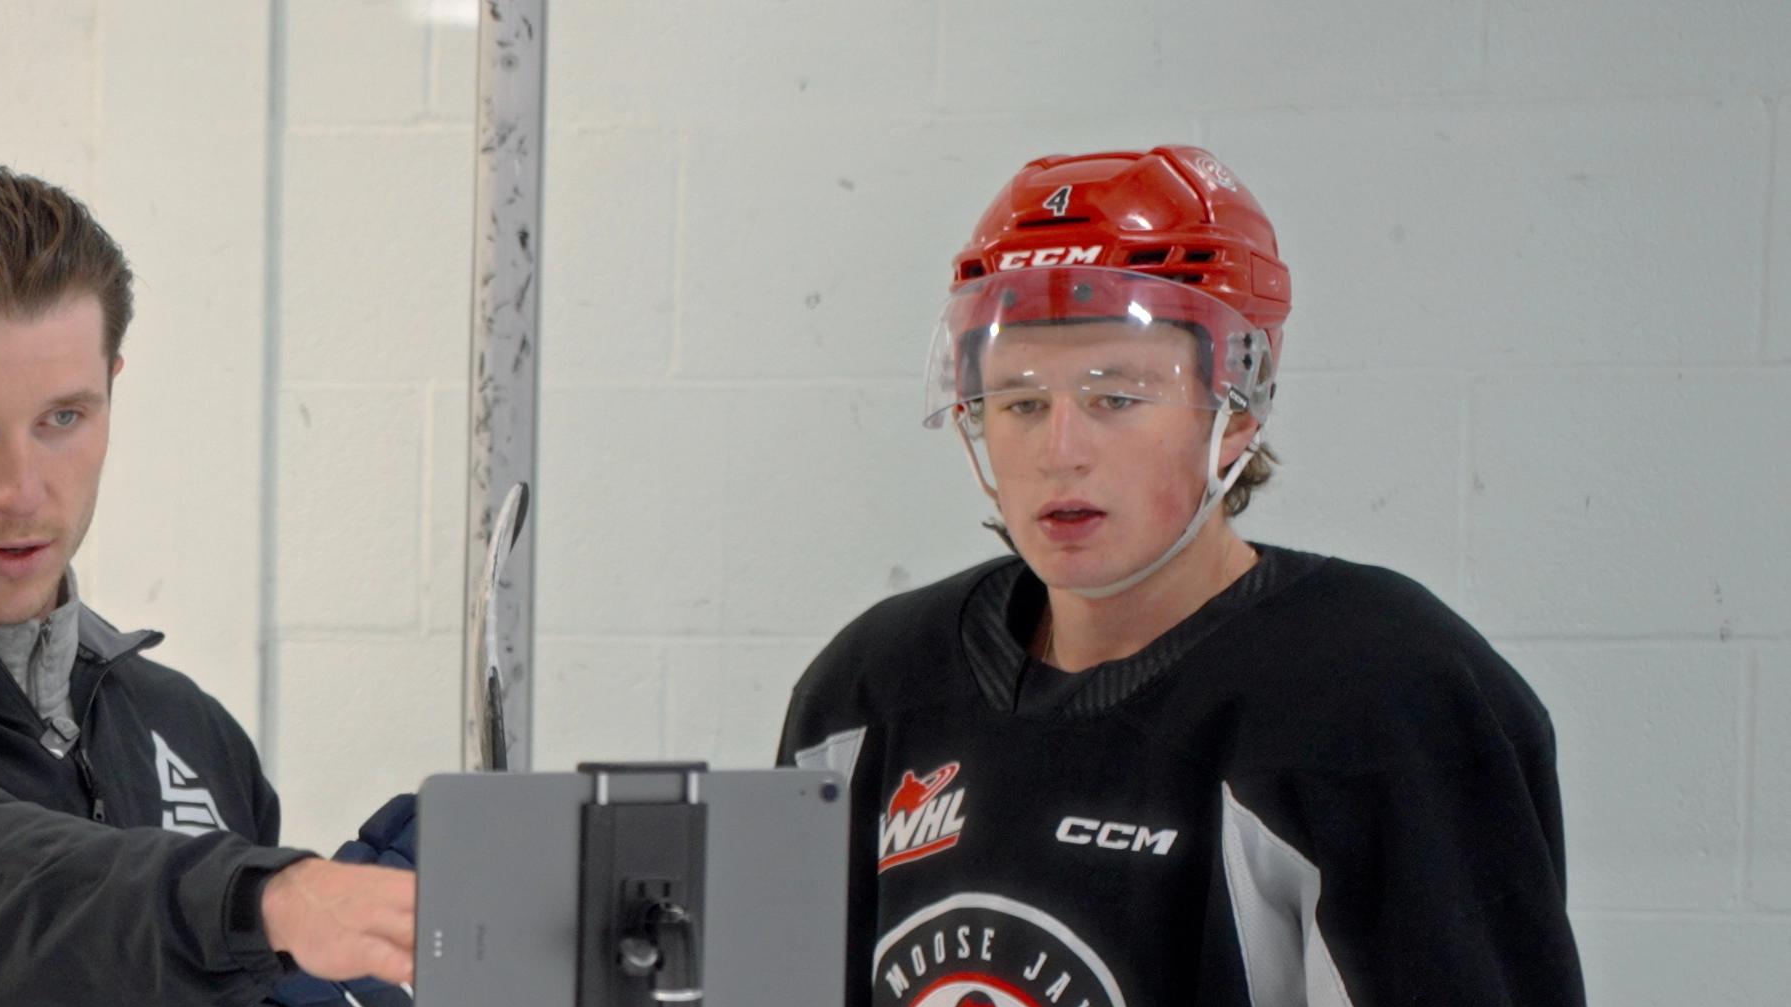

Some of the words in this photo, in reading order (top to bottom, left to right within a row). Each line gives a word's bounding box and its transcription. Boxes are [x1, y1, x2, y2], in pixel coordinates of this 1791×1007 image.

[1042, 184, 1073, 217] 4
[999, 245, 1103, 271] CCM
[878, 787, 966, 861] WHL
[1055, 816, 1179, 856] CCM
[885, 925, 996, 999] MOOSE
